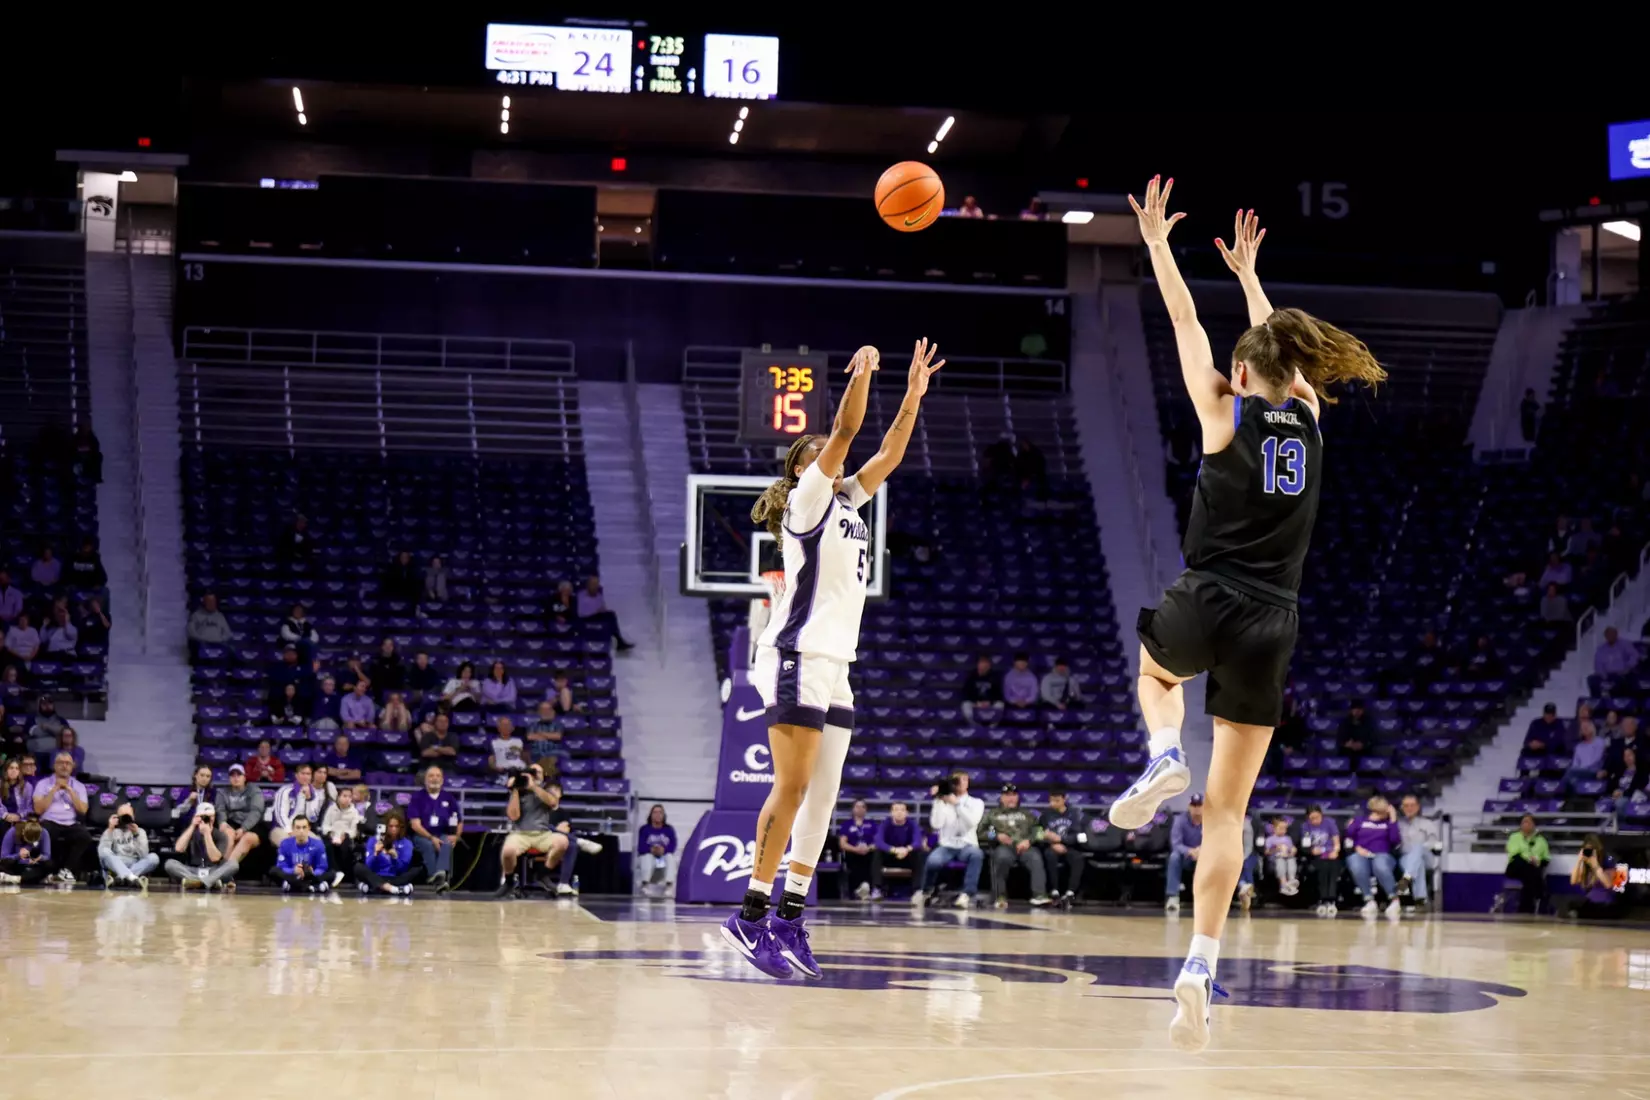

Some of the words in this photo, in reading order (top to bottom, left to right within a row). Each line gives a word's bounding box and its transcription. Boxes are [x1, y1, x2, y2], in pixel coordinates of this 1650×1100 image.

[650, 36, 684, 54] 7:35
[572, 51, 614, 77] 24
[722, 59, 761, 84] 16
[497, 70, 526, 84] 4:31
[529, 71, 553, 85] PM
[650, 80, 682, 93] FOULS
[1297, 182, 1350, 219] 15
[184, 263, 204, 281] 13
[1045, 299, 1065, 315] 14
[768, 366, 814, 392] 7:35
[773, 392, 807, 433] 15
[1261, 436, 1307, 496] 13
[857, 549, 866, 583] 5
